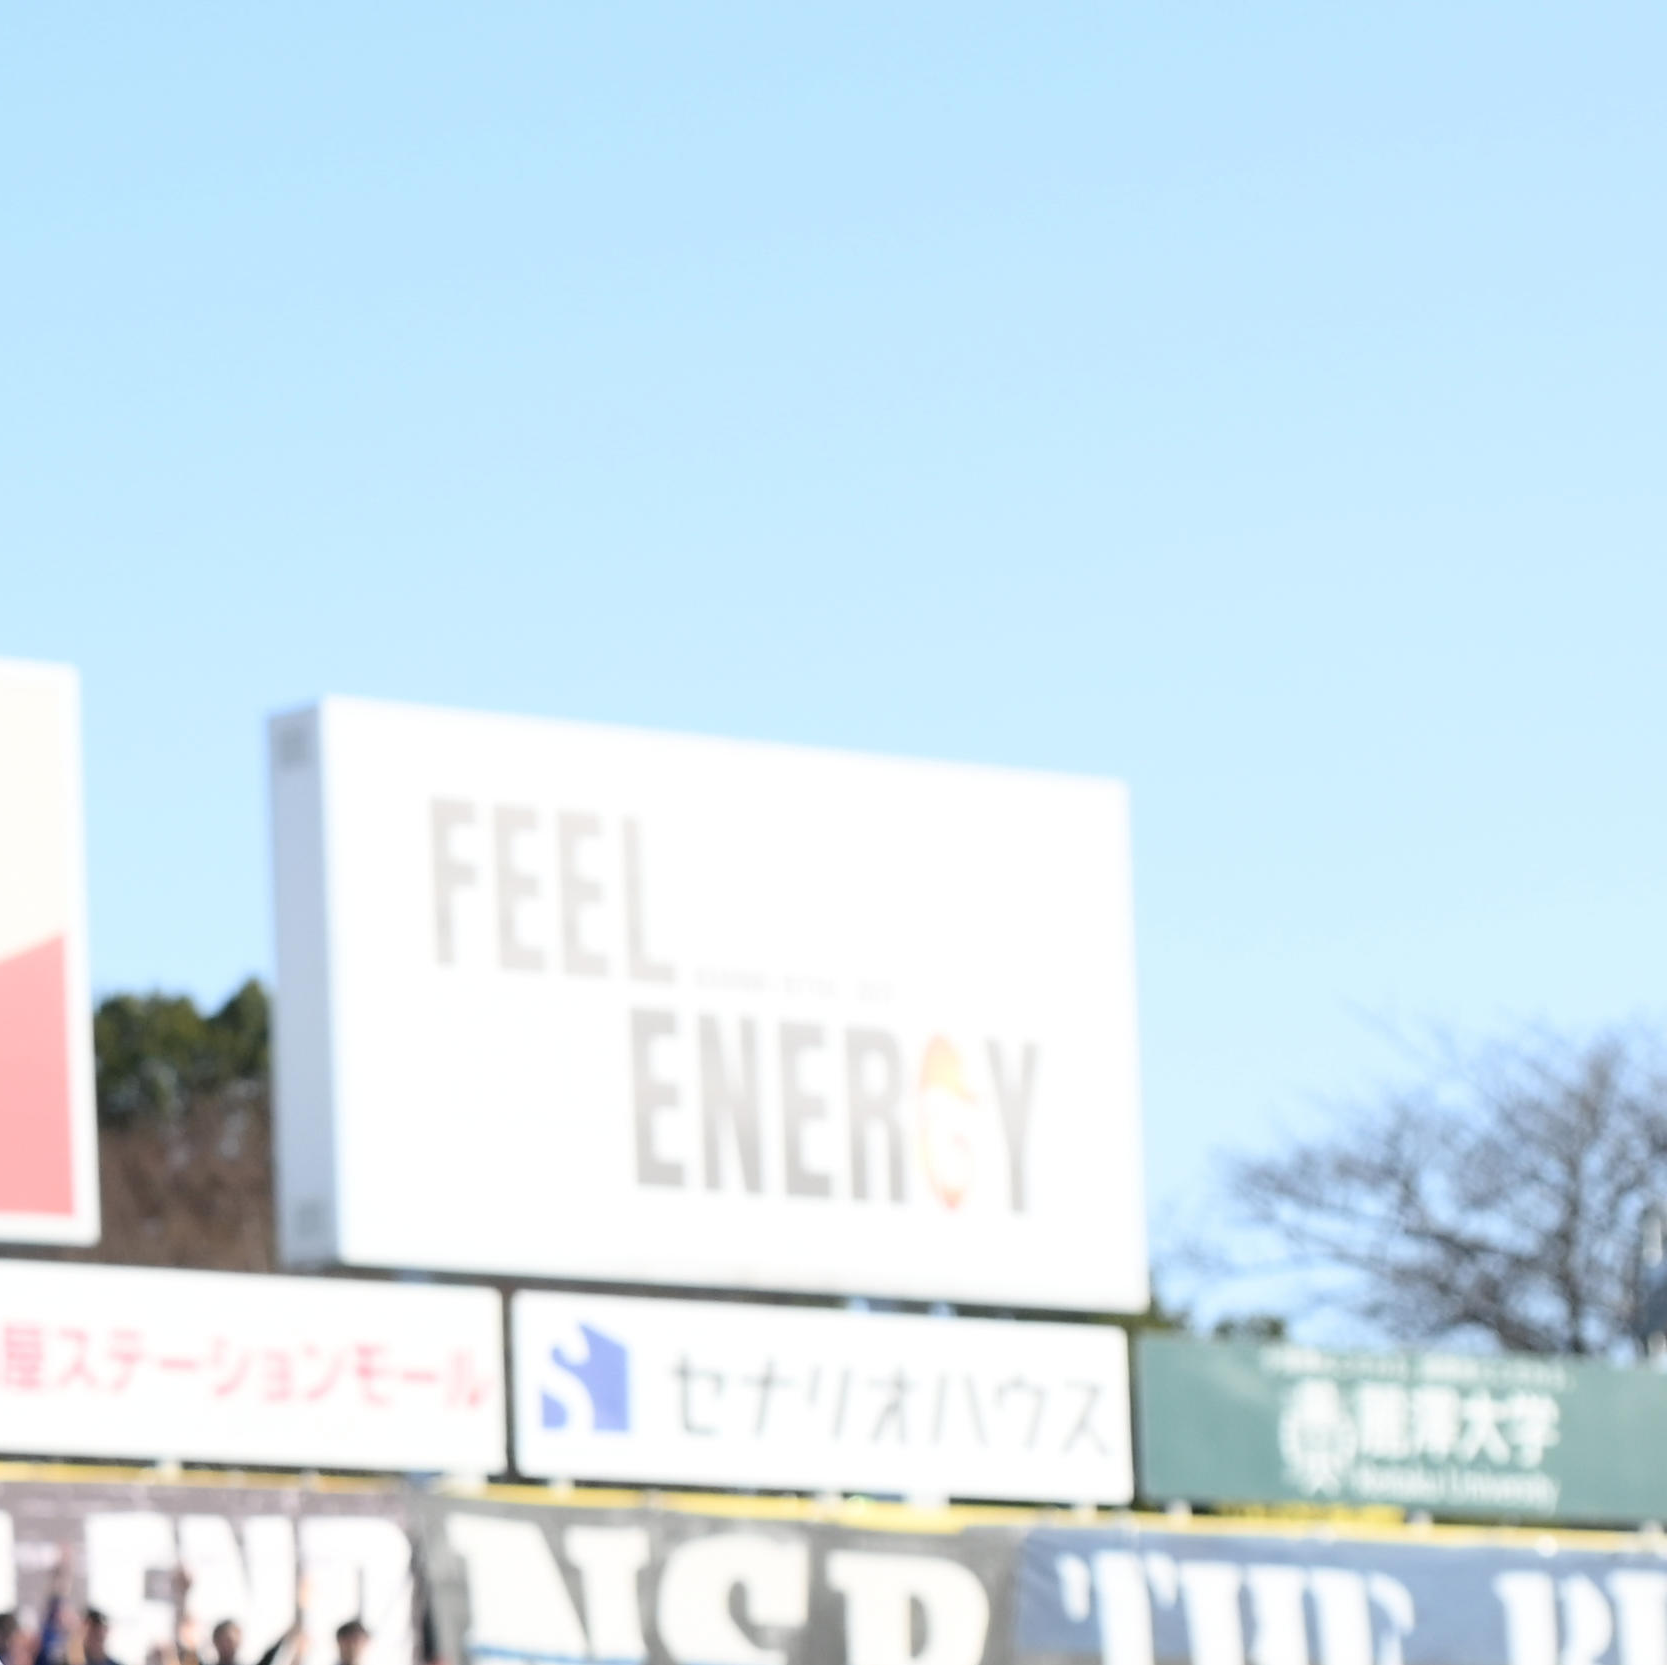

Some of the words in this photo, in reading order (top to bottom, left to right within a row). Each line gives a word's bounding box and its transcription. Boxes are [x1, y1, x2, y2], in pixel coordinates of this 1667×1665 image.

[430, 795, 677, 985] FEEL
[629, 1005, 1041, 1214] ENERGY
[673, 1350, 1113, 1458] セナリオハウス
